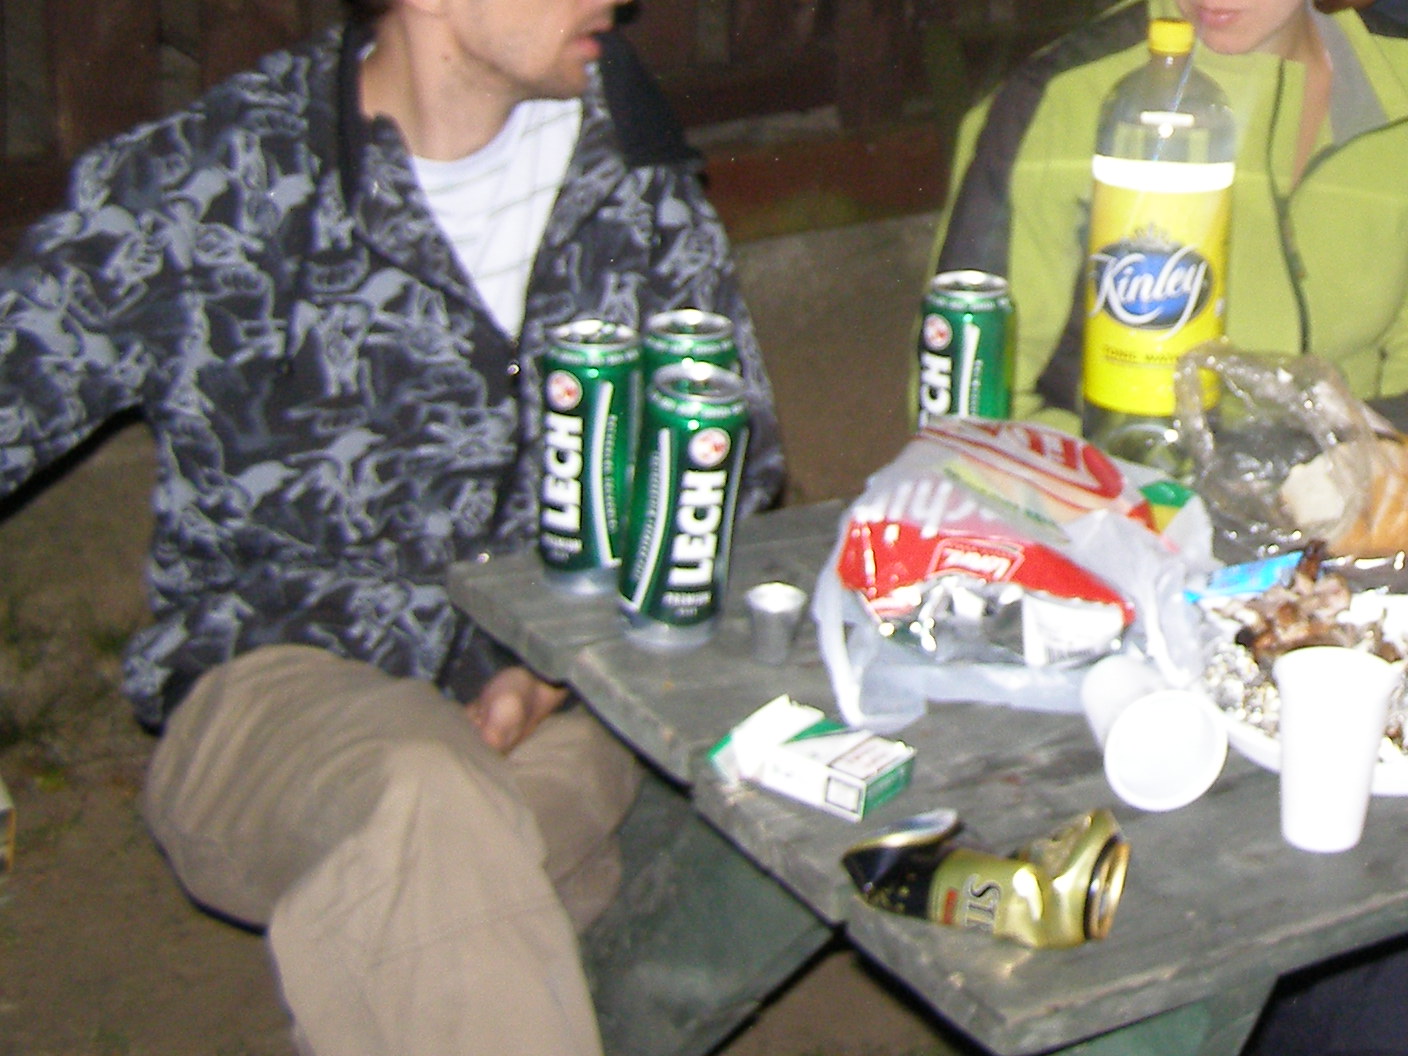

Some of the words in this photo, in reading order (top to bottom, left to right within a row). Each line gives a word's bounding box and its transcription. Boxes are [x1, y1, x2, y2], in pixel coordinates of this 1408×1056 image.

[1088, 245, 1208, 342] Kinley
[919, 352, 953, 429] CH
[541, 411, 583, 533] LECH
[667, 469, 727, 587] LECH
